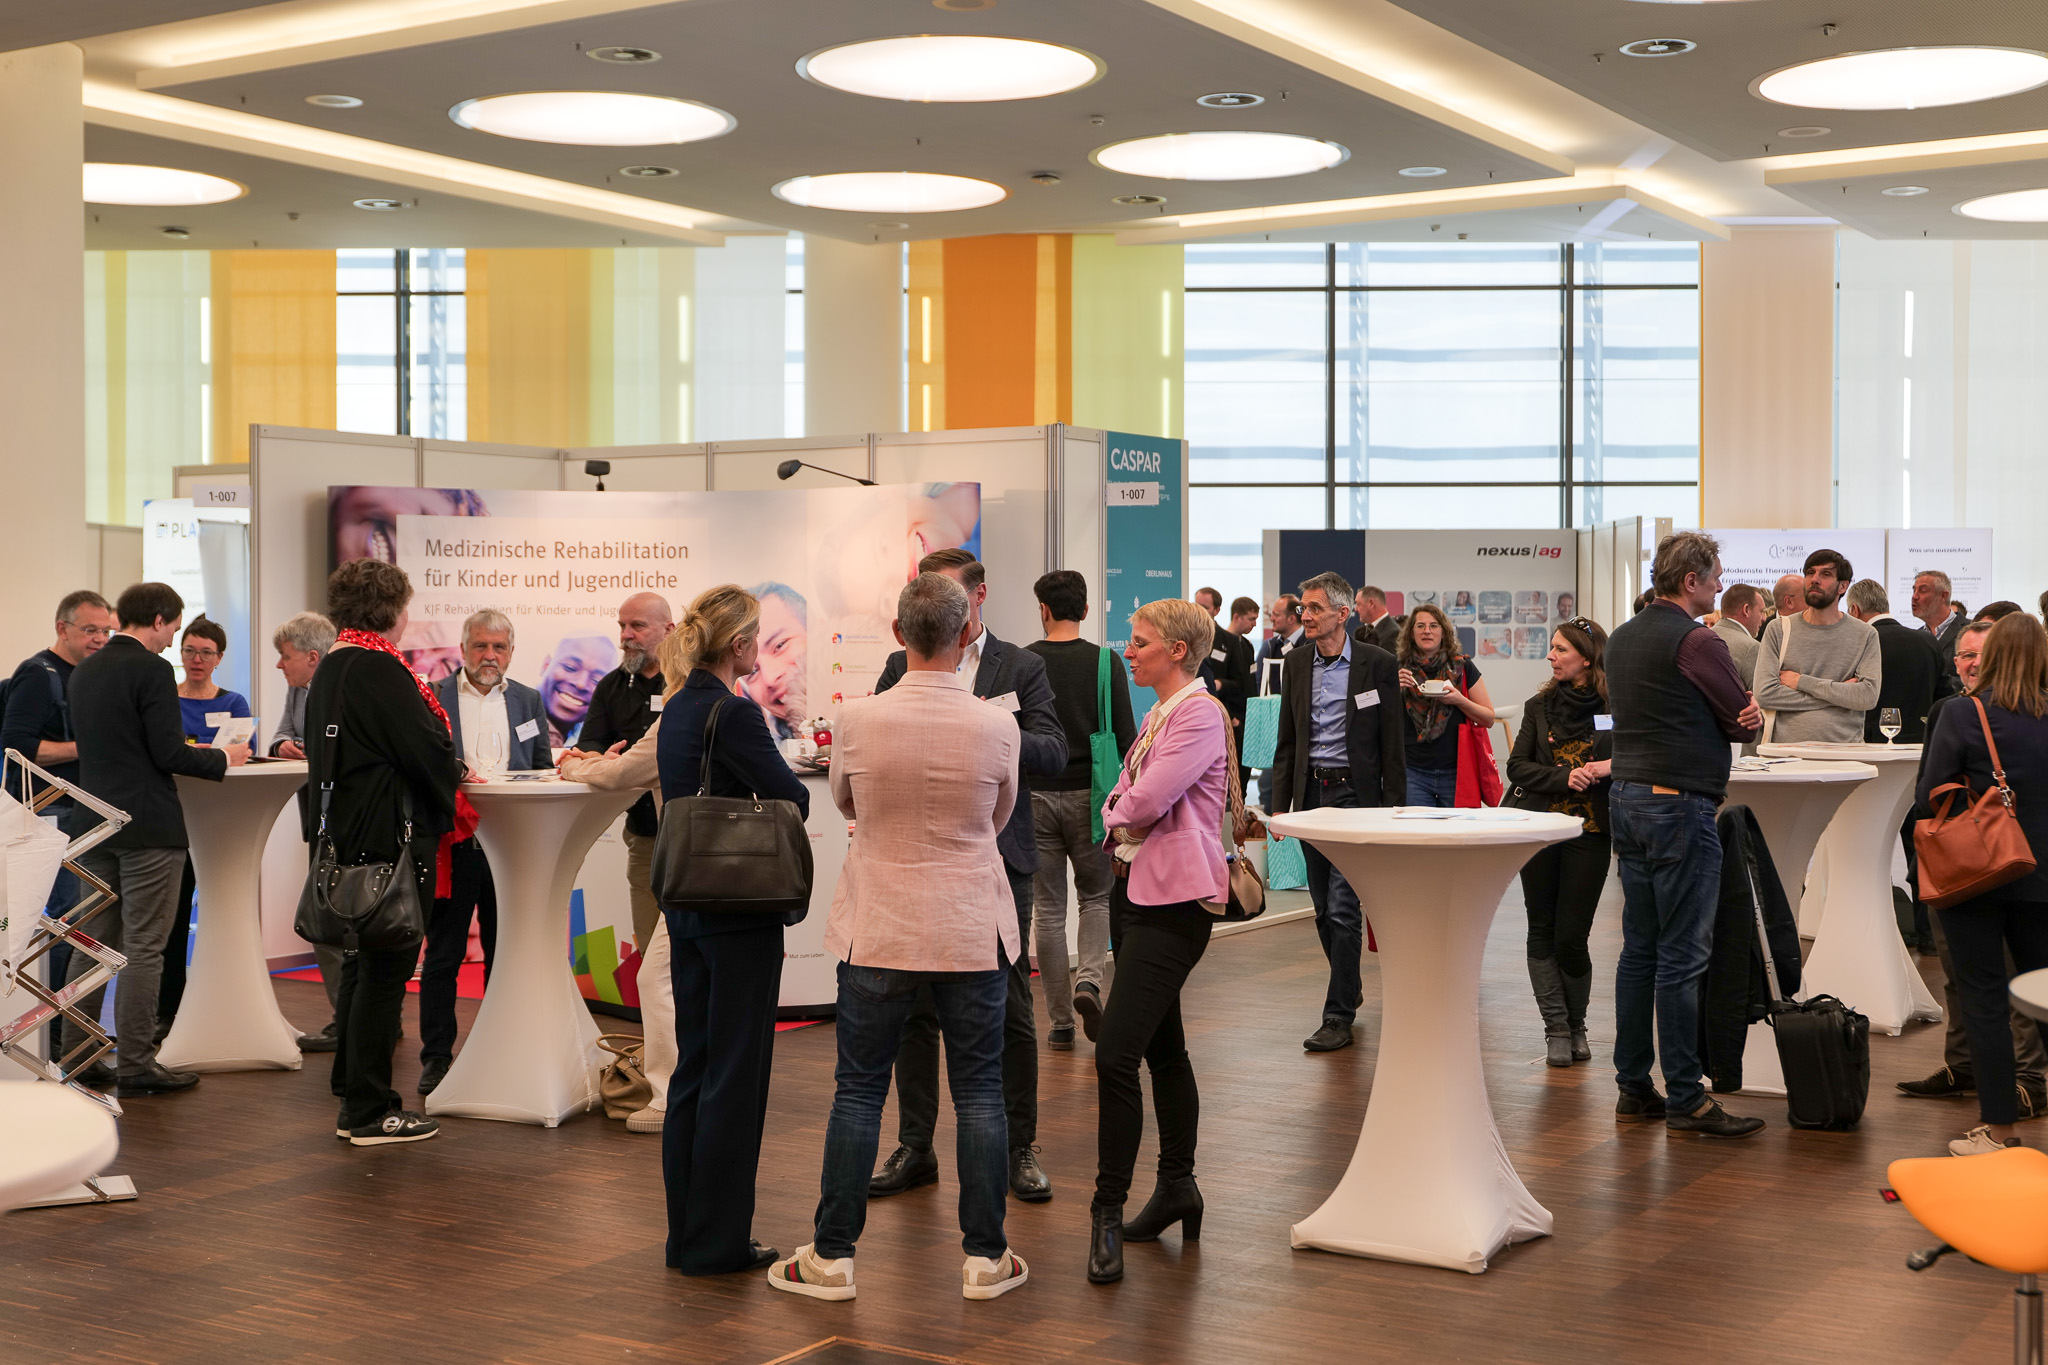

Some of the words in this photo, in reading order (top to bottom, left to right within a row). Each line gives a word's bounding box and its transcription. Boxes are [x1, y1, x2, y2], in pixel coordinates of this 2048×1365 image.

[1110, 447, 1161, 474] CASPAR
[208, 491, 237, 502] 1-007
[1120, 489, 1145, 500] 1-007
[171, 522, 199, 538] PLA
[424, 538, 547, 559] Medizinische
[554, 541, 689, 559] Rehabilitation
[1765, 567, 1798, 576] Therapie
[424, 568, 451, 587] für
[458, 569, 518, 588] Kinder
[524, 570, 560, 588] und
[567, 570, 678, 592] Jugendliche
[1721, 578, 1770, 586] Ergotherapie
[424, 604, 441, 616] KJF
[444, 604, 512, 615] Rehakliiken
[516, 604, 533, 615] für
[536, 604, 571, 616] Kinder
[575, 605, 595, 616] und
